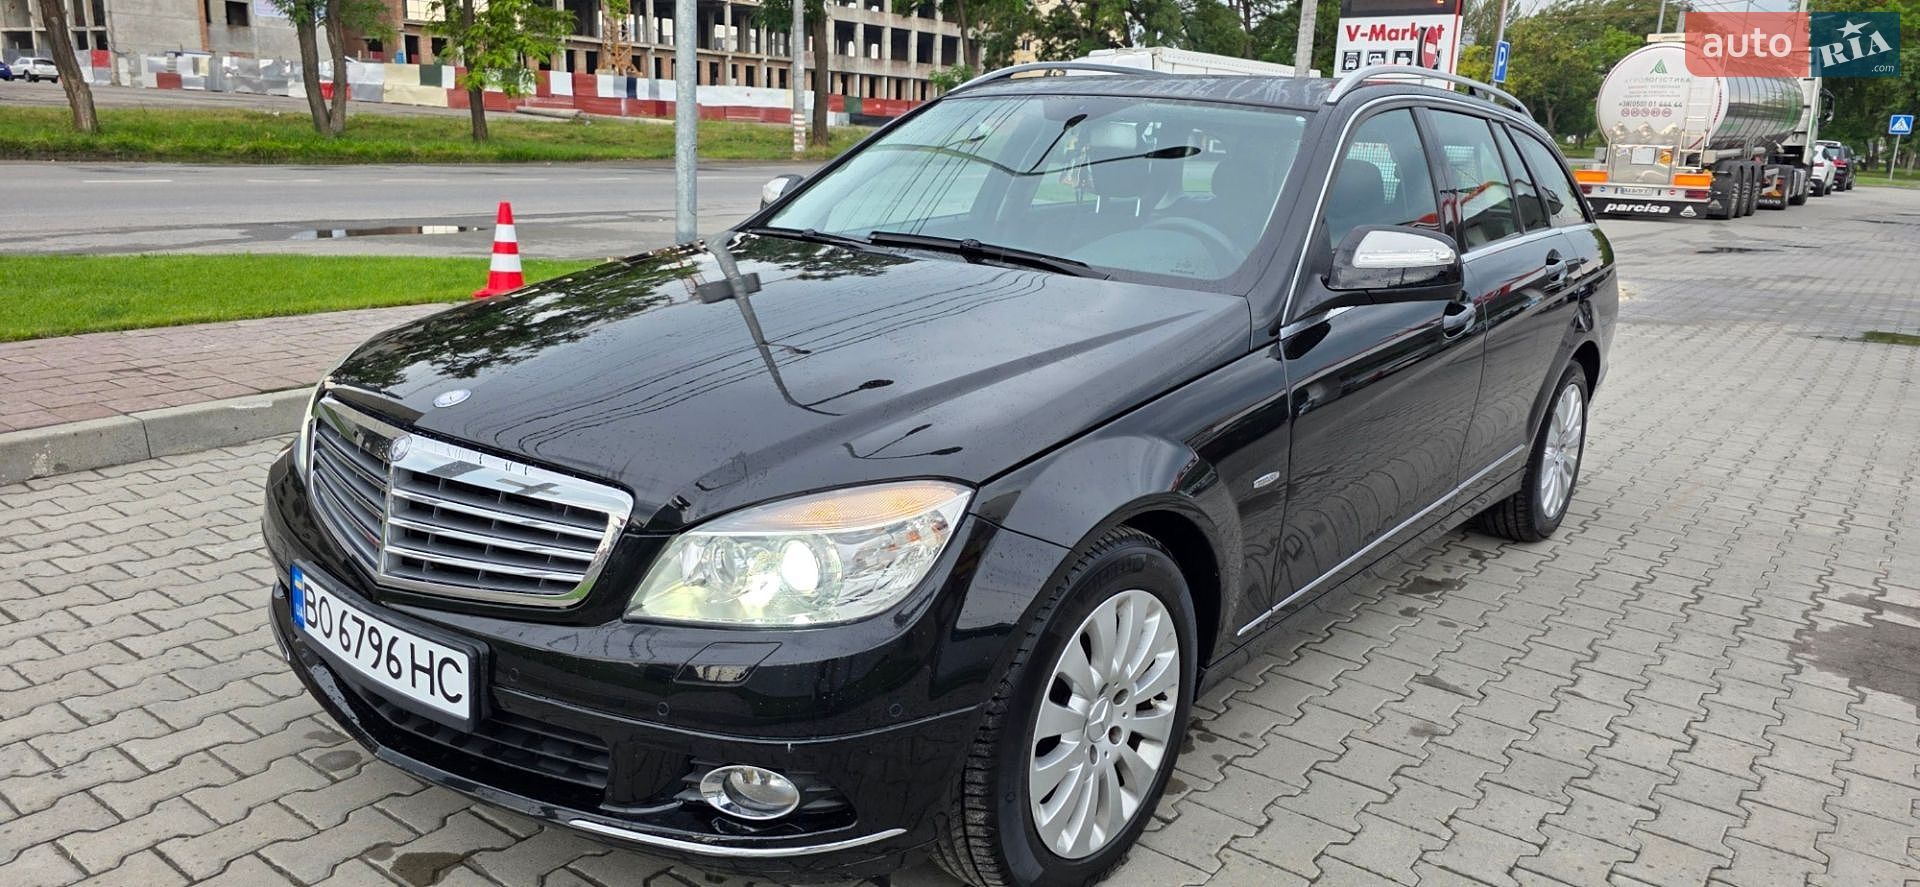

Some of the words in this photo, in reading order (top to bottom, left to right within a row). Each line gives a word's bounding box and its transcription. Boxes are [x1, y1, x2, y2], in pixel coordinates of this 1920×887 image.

[1346, 23, 1445, 42] V-Markt
[1496, 46, 1506, 77] P
[1603, 202, 1671, 214] parcisa
[304, 582, 333, 639] BO
[339, 609, 402, 680] 6796
[410, 642, 463, 704] HC
